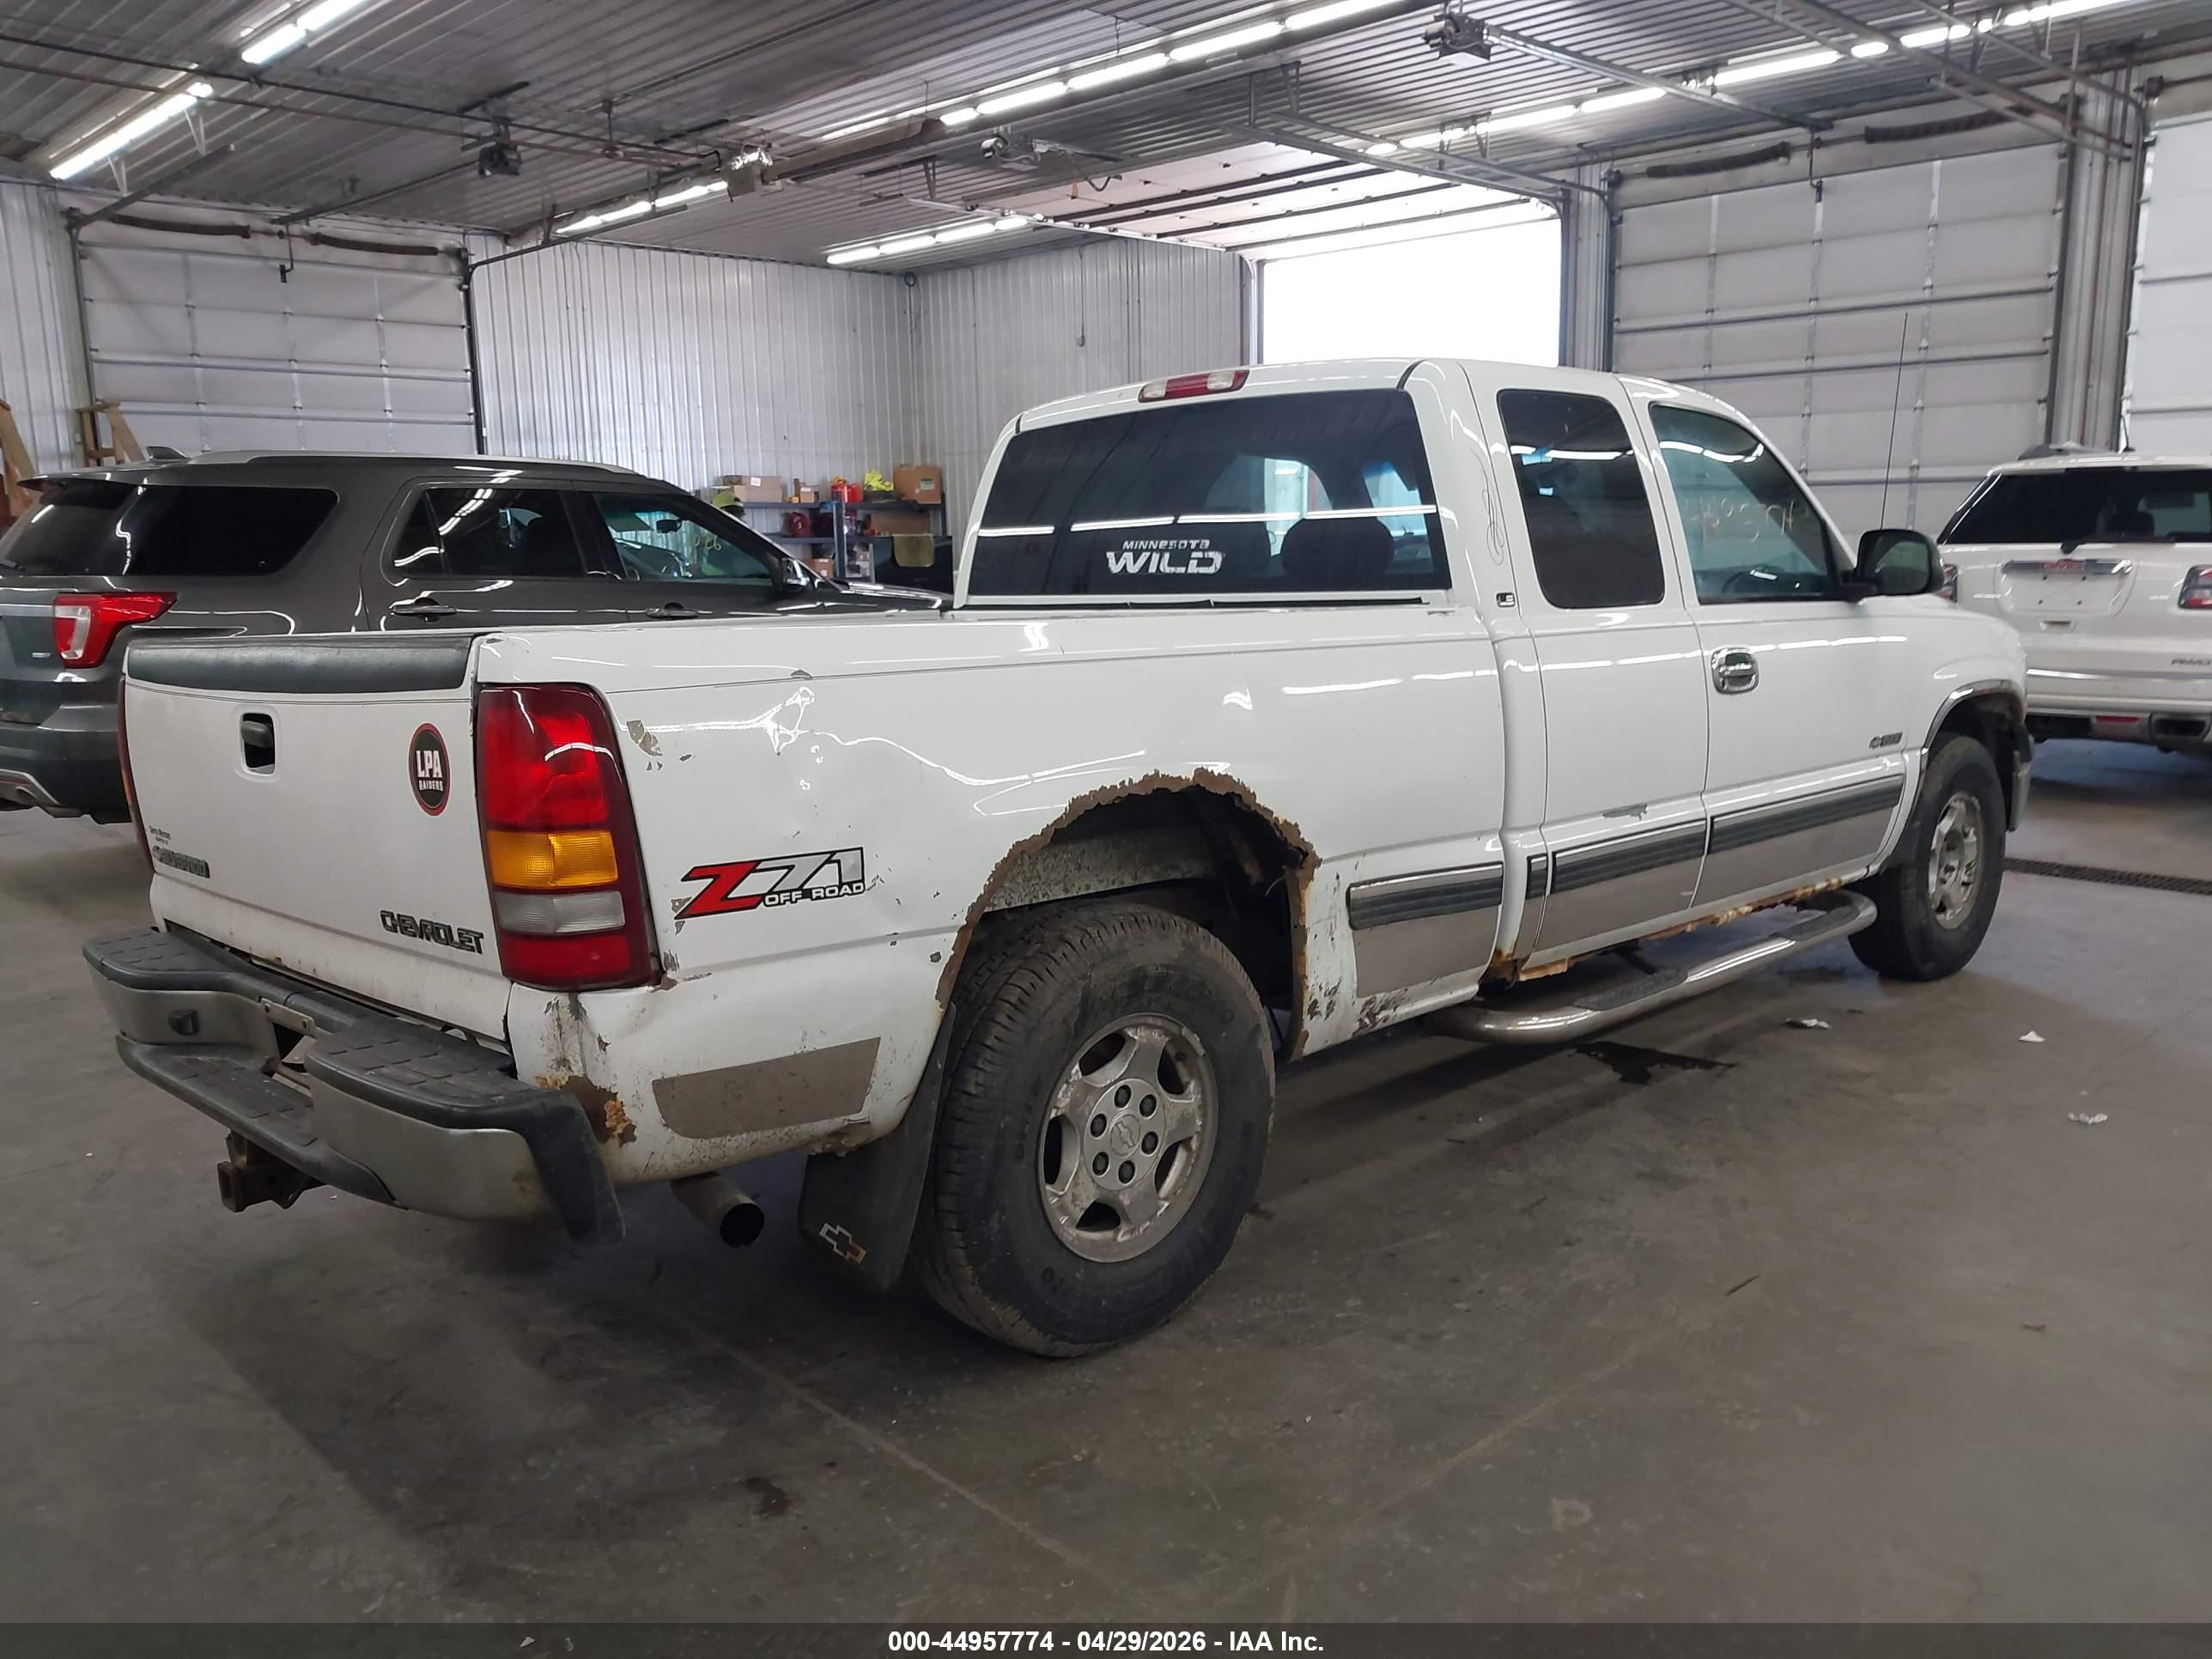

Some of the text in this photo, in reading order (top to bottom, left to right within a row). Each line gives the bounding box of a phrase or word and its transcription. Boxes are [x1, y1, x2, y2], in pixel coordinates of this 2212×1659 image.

[1106, 551, 1223, 574] WILD
[416, 750, 443, 778] LPA
[418, 780, 444, 791] RAIDERS
[674, 847, 865, 921] Z71
[764, 883, 865, 906] OFF ROAD
[380, 909, 484, 955] CHEVROLET
